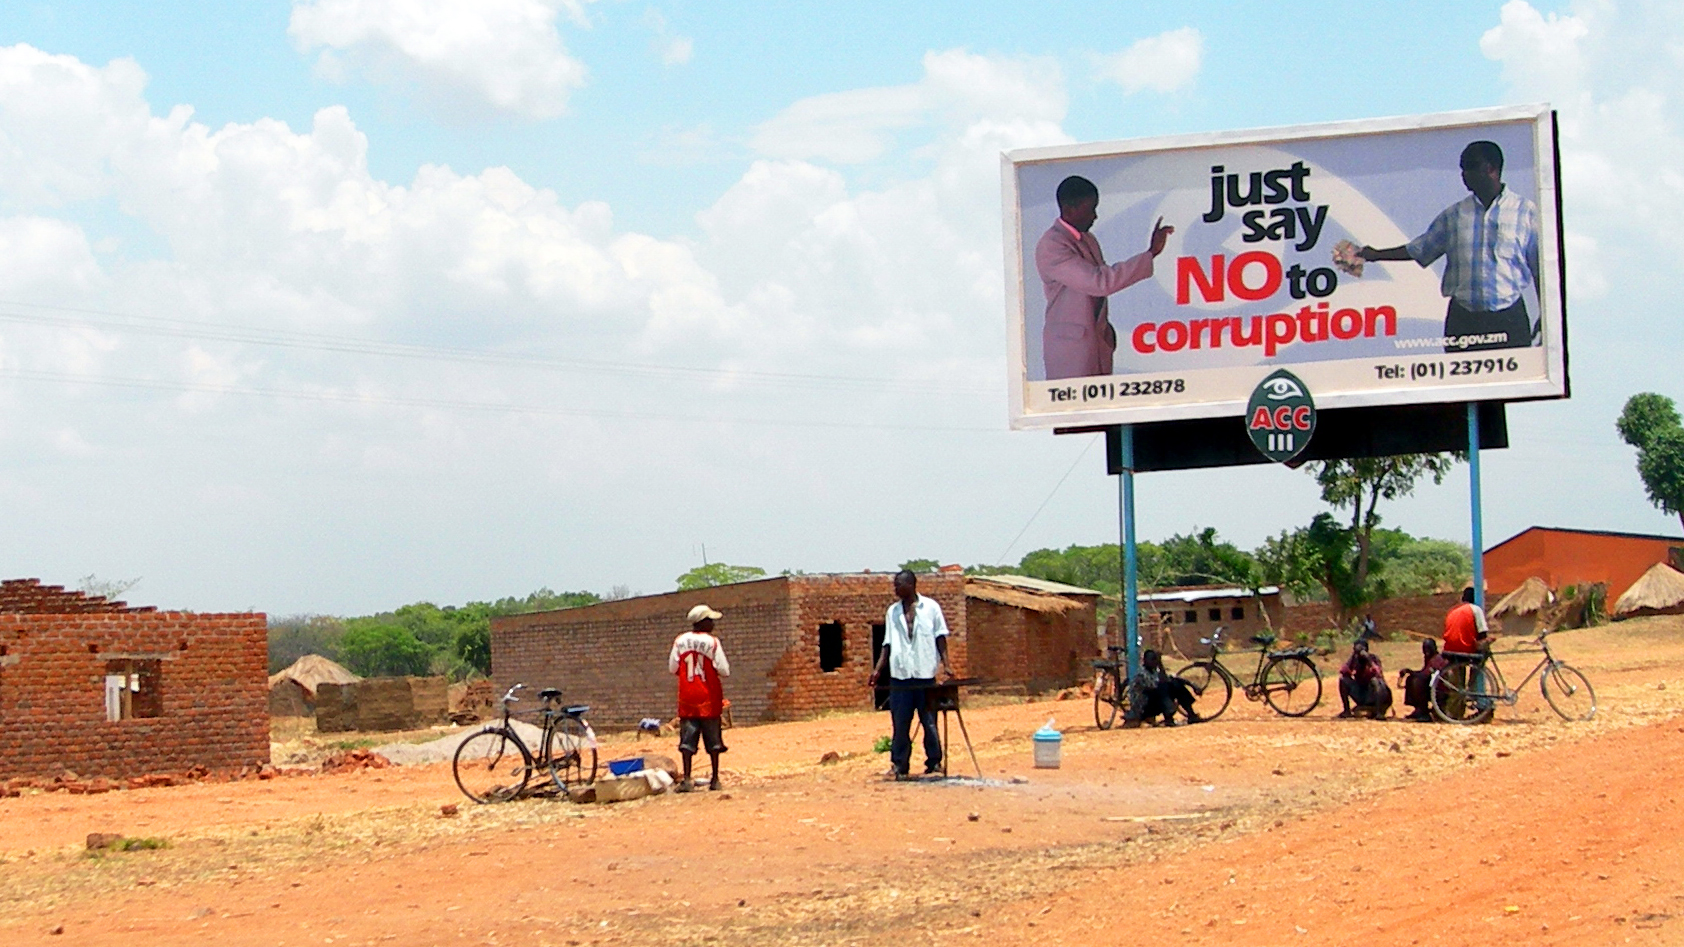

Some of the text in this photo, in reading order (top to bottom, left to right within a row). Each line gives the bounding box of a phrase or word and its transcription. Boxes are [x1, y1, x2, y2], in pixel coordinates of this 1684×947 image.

[1202, 161, 1310, 223] just
[1242, 204, 1329, 252] say
[1176, 250, 1338, 305] NO to
[1131, 301, 1397, 357] corruption
[1394, 332, 1508, 349] www.acc.gov.zm
[1374, 357, 1519, 381] Tel: (01) 237916
[1048, 379, 1186, 402] Tel: (01) 232878
[1250, 405, 1311, 431] ACC
[684, 652, 706, 683] 14
